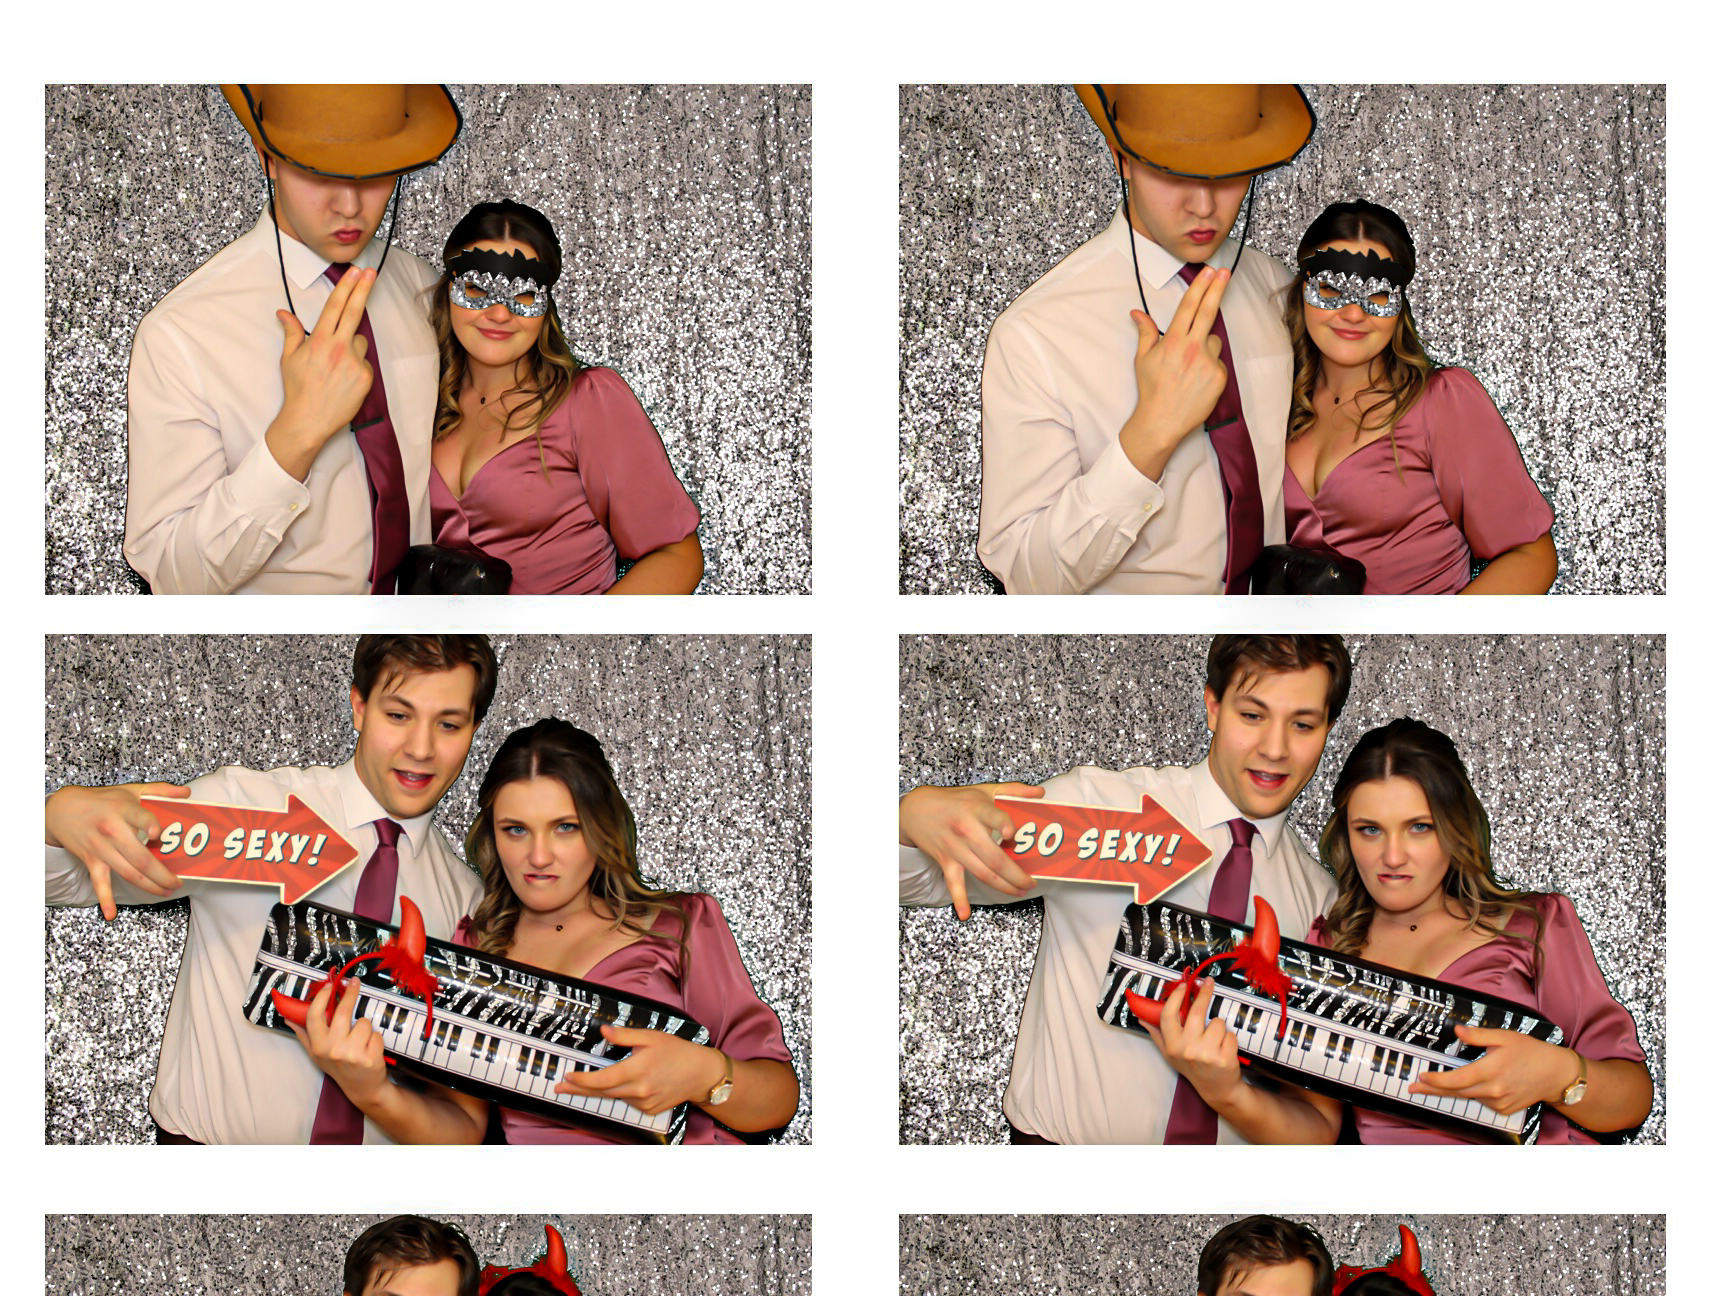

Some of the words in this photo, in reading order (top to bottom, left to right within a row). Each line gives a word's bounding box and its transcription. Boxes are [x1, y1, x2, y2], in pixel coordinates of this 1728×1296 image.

[159, 821, 210, 857] SO
[223, 827, 328, 866] SEXY!
[1013, 821, 1064, 857] SO
[1077, 827, 1182, 866] SEXY!
